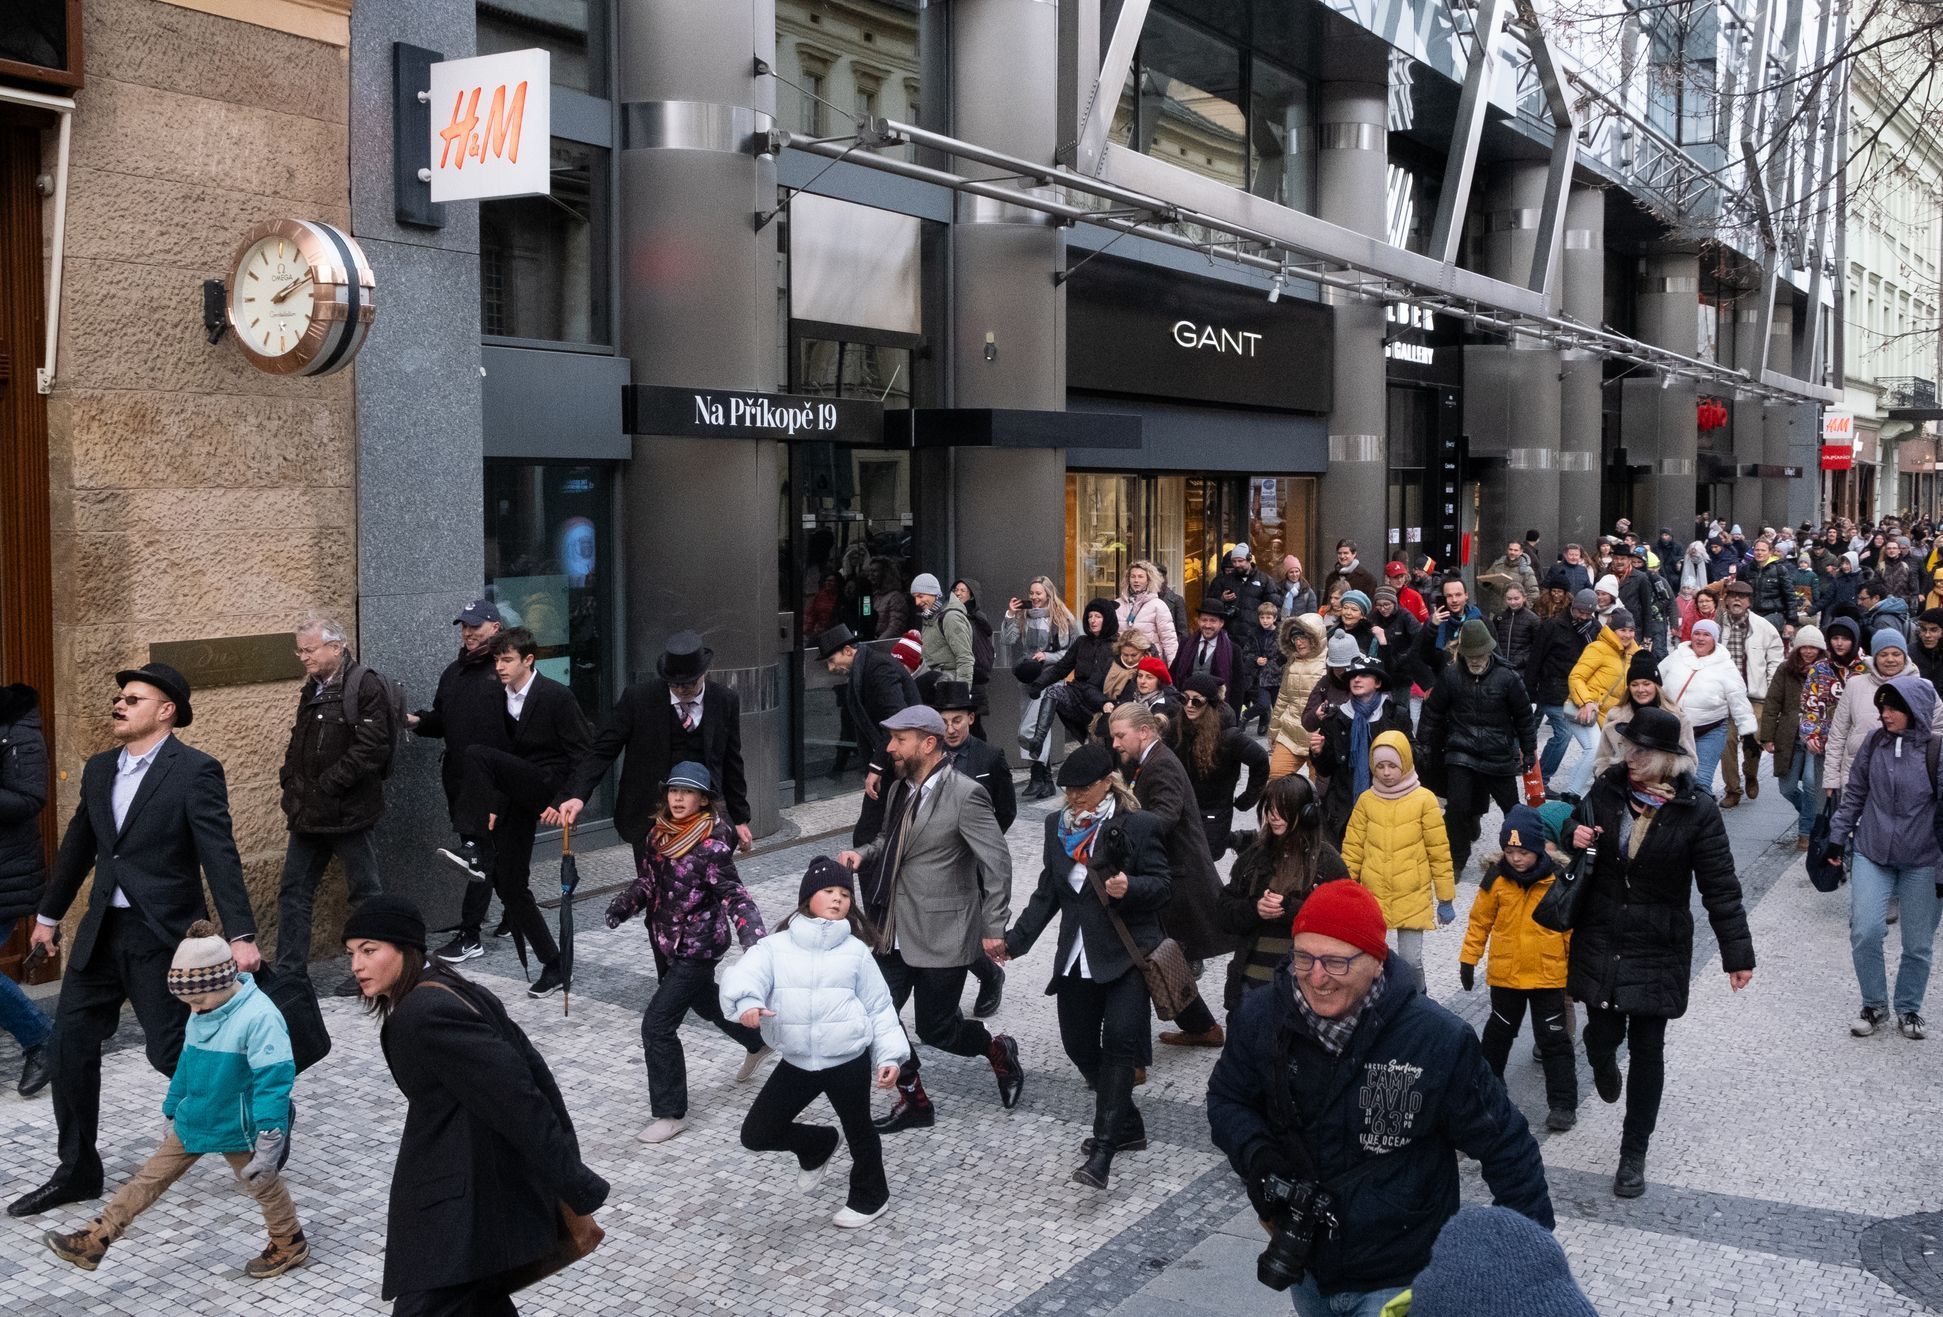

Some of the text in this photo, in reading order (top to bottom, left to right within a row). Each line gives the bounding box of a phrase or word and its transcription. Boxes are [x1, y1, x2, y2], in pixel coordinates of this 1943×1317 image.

[440, 81, 527, 169] H&M
[272, 274, 293, 282] OMEGA
[1173, 320, 1263, 357] GANT
[1392, 341, 1434, 365] GALLERY
[694, 395, 837, 435] Na Příkopě 19
[1507, 829, 1522, 846] A
[1364, 1059, 1424, 1079] ARCTIC Surfing
[1366, 1069, 1416, 1091] CAMP
[1358, 1086, 1423, 1114] DAVID
[1371, 1109, 1402, 1136] 63
